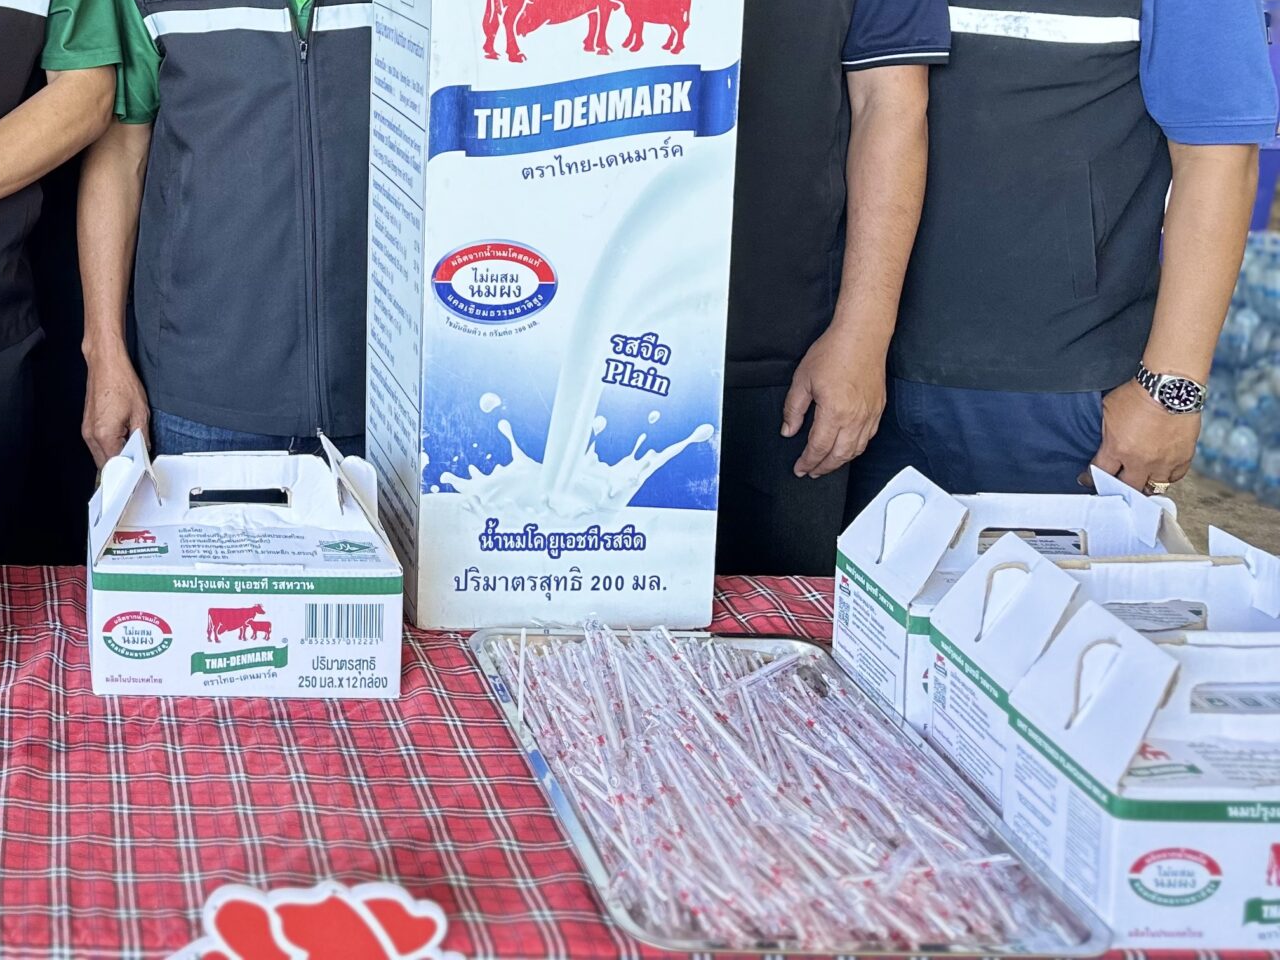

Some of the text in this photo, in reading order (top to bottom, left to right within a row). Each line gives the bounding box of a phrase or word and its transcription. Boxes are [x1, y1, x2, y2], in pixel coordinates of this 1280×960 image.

[474, 81, 693, 139] THAI-DENMARK
[522, 137, 684, 181] ตราไทย-เดนมาร์ค
[450, 246, 543, 267] ผลิตจากน้ำนมโคสดแท้
[472, 267, 519, 283] ไม่ผสม
[469, 285, 522, 298] นมผง
[447, 294, 544, 317] แคลเซียมธรรมชาติสูง
[610, 332, 671, 365] รสจืด
[603, 359, 671, 396] Plain
[480, 519, 646, 558] น้ำนมโค ยูเอชที รสจืด
[173, 577, 315, 593] นมปรุงแต่ง ยูเอชที รสหวาน
[454, 567, 667, 601] ปริมาตรสุทธิ 200 มล.
[122, 636, 154, 645] นมผง
[123, 626, 152, 636] ไม่ผสม
[205, 651, 274, 669] THAI-DENMARK
[312, 655, 376, 675] ปริมาตรสุทธิ
[298, 676, 317, 688] 250
